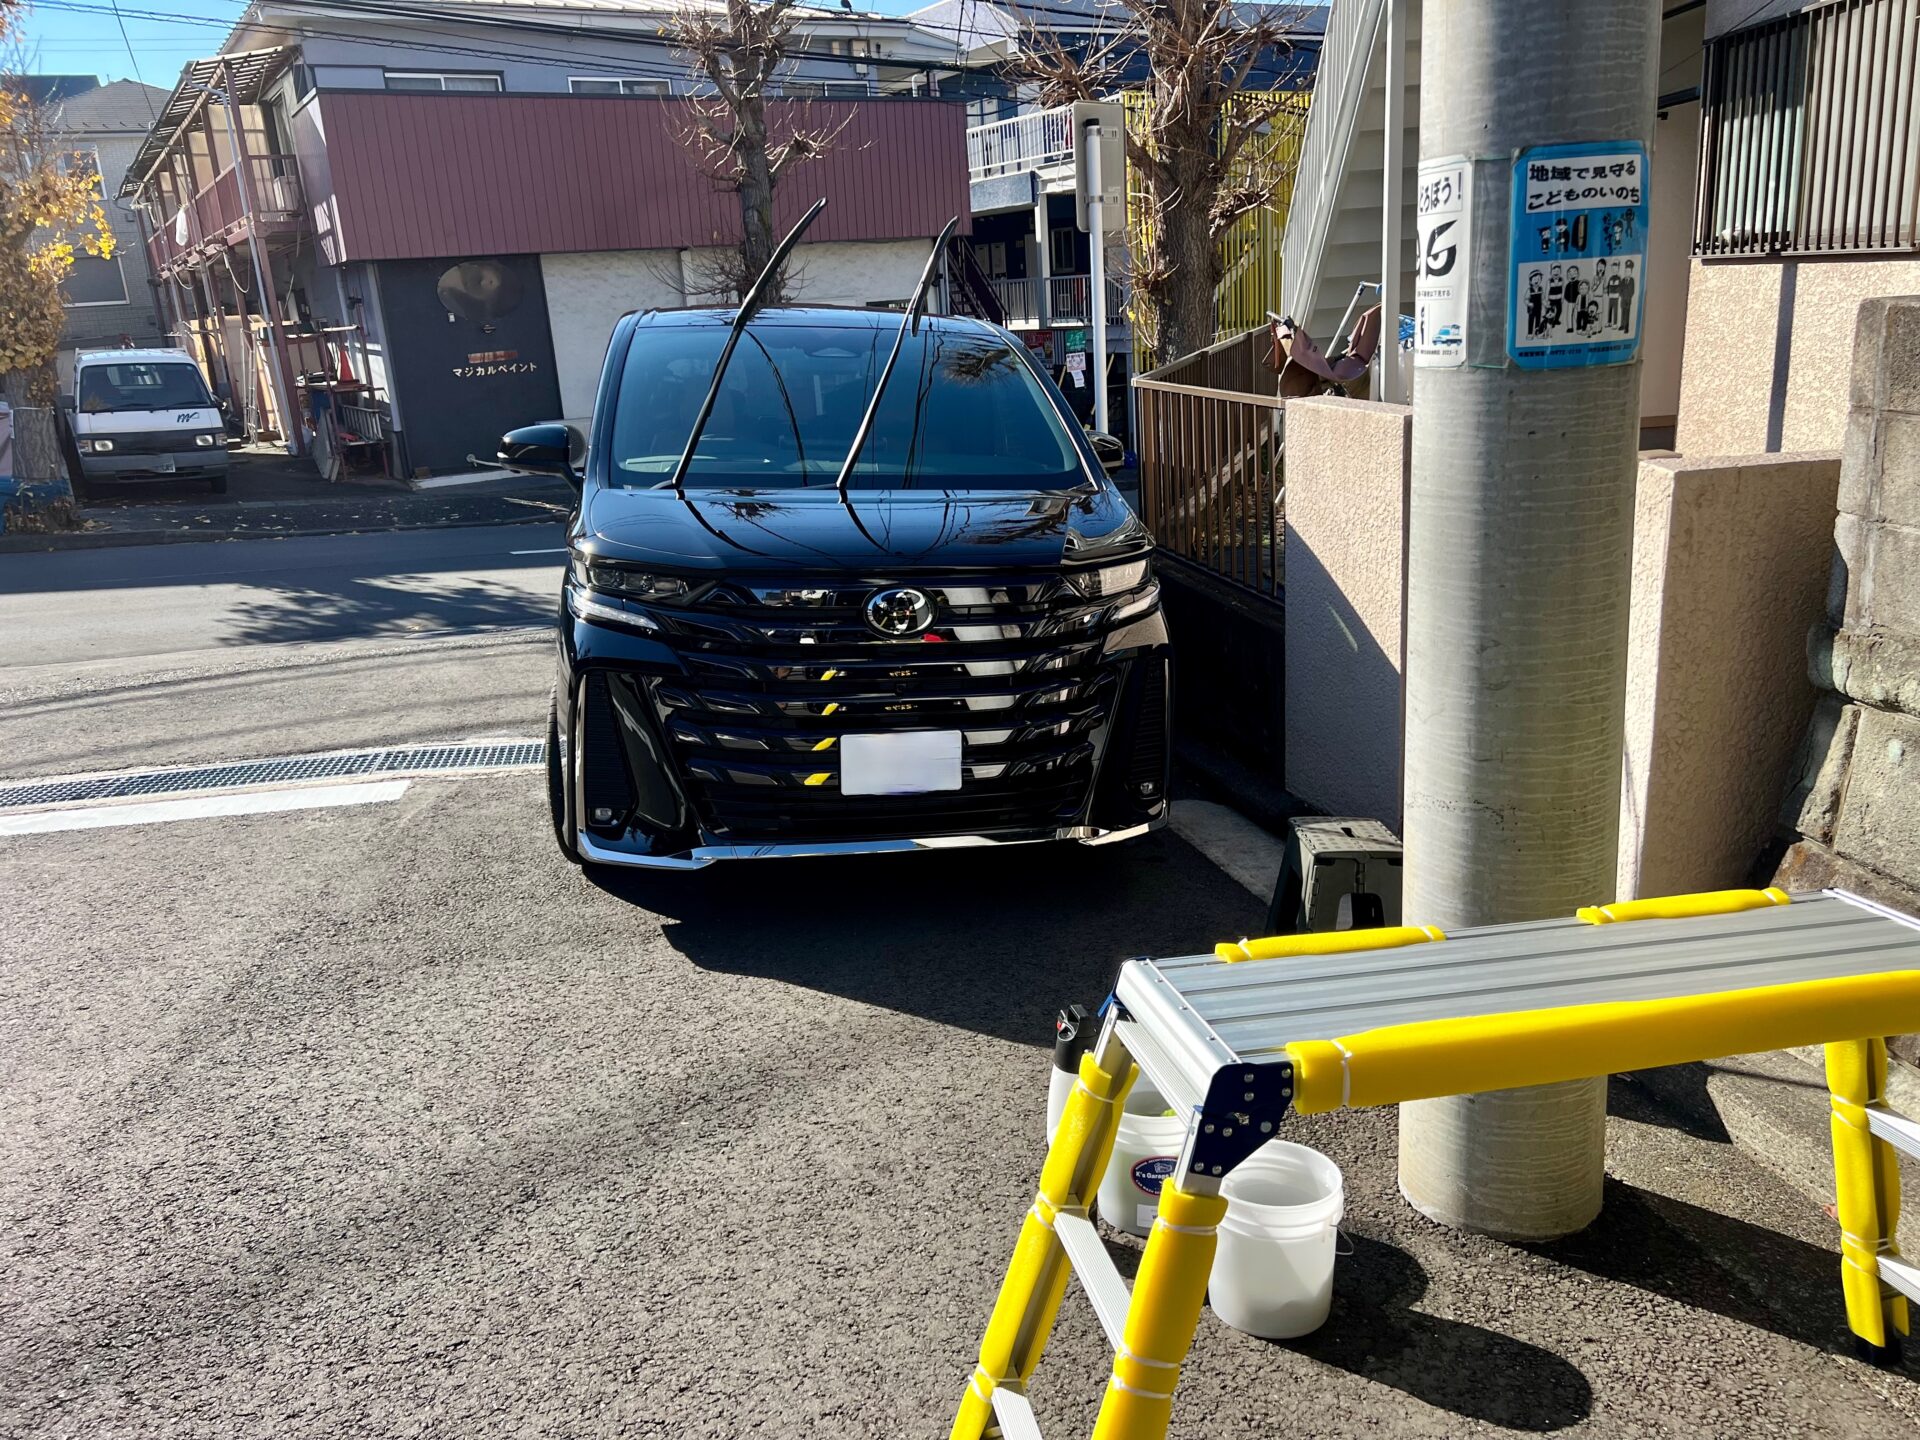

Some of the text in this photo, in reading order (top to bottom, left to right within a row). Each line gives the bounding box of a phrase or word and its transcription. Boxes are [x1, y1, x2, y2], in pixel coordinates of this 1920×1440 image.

[1529, 160, 1636, 182] 地域で見守る
[1527, 186, 1640, 210] こどものいのち
[453, 362, 537, 377] マジカルペイント
